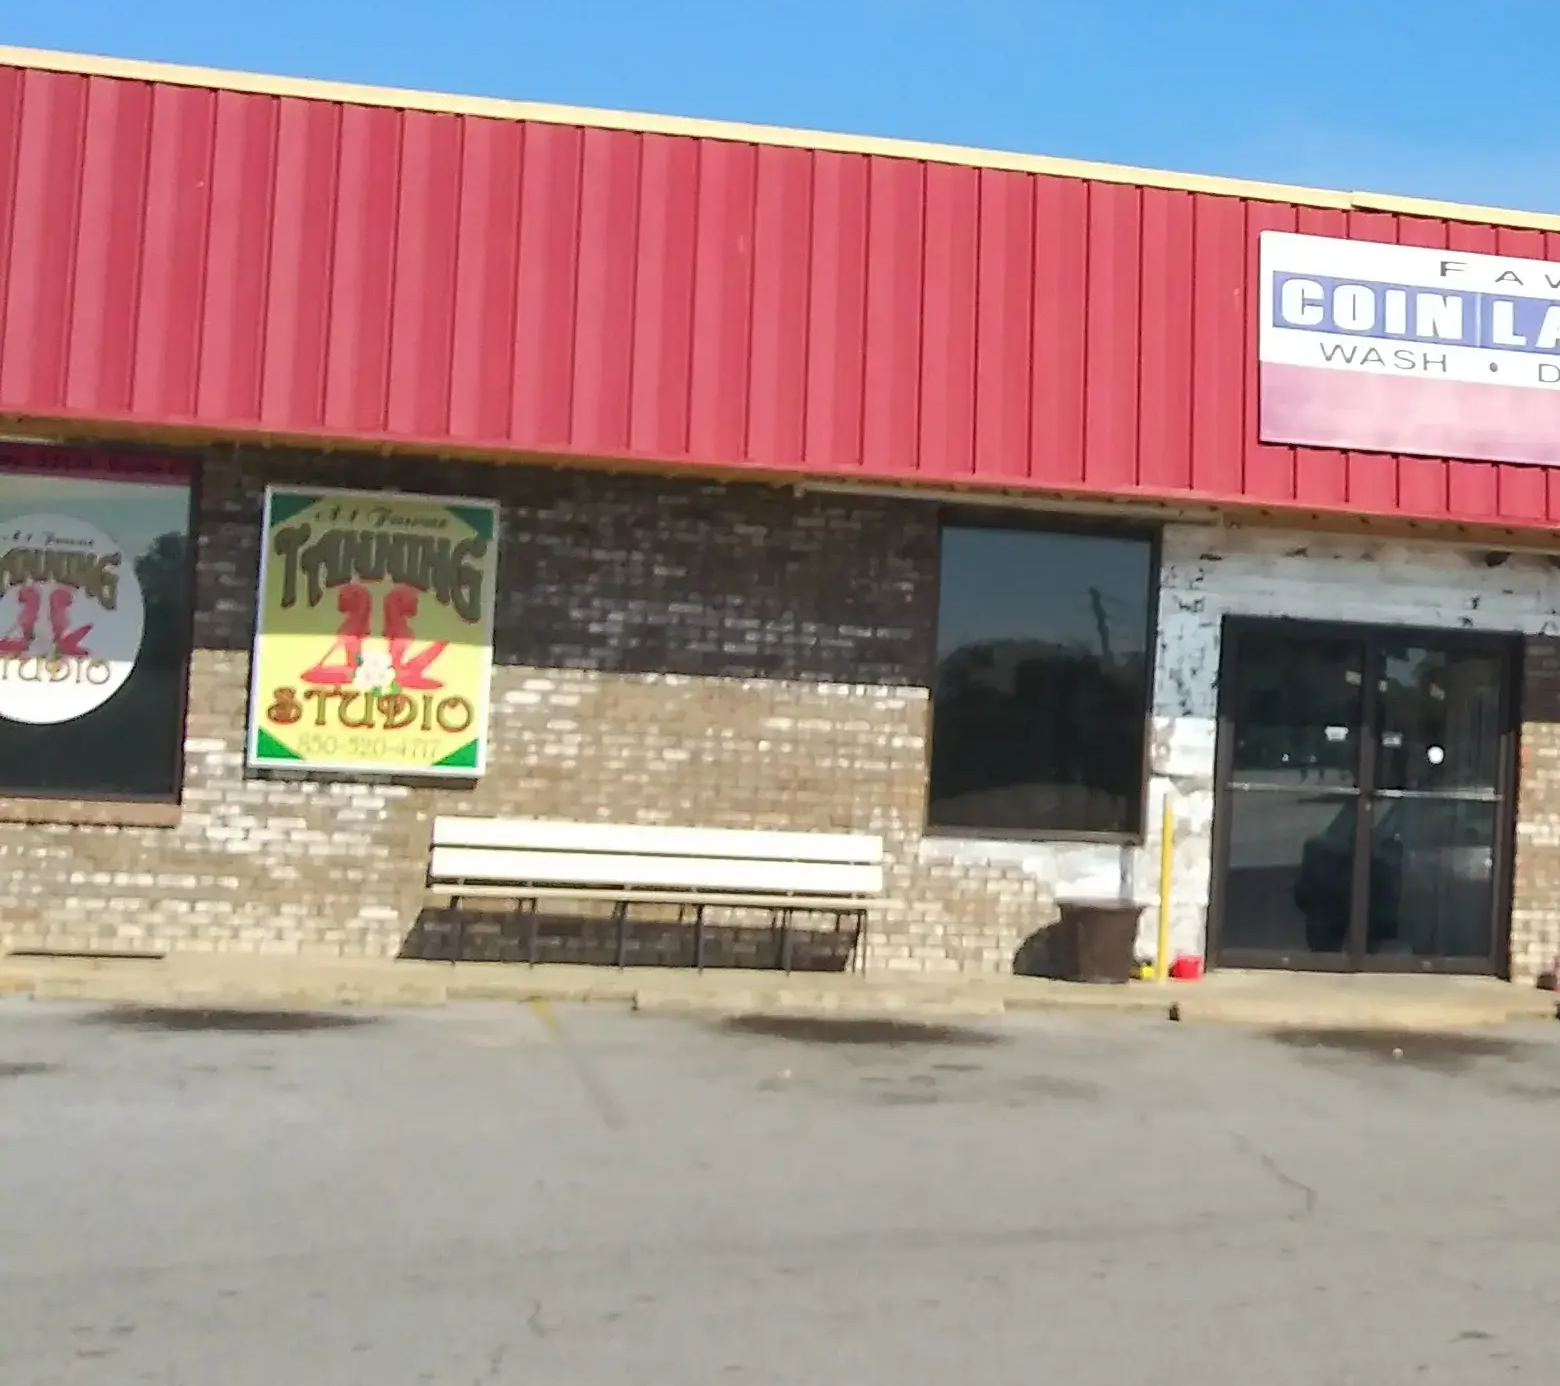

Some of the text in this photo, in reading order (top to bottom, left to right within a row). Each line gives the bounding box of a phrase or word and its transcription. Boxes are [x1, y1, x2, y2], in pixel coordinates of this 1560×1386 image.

[1281, 277, 1463, 340] COIN
[1320, 341, 1448, 374] WASH
[274, 521, 490, 624] TANNING
[0, 656, 111, 685] TUDIO
[266, 685, 475, 733] STUDIO
